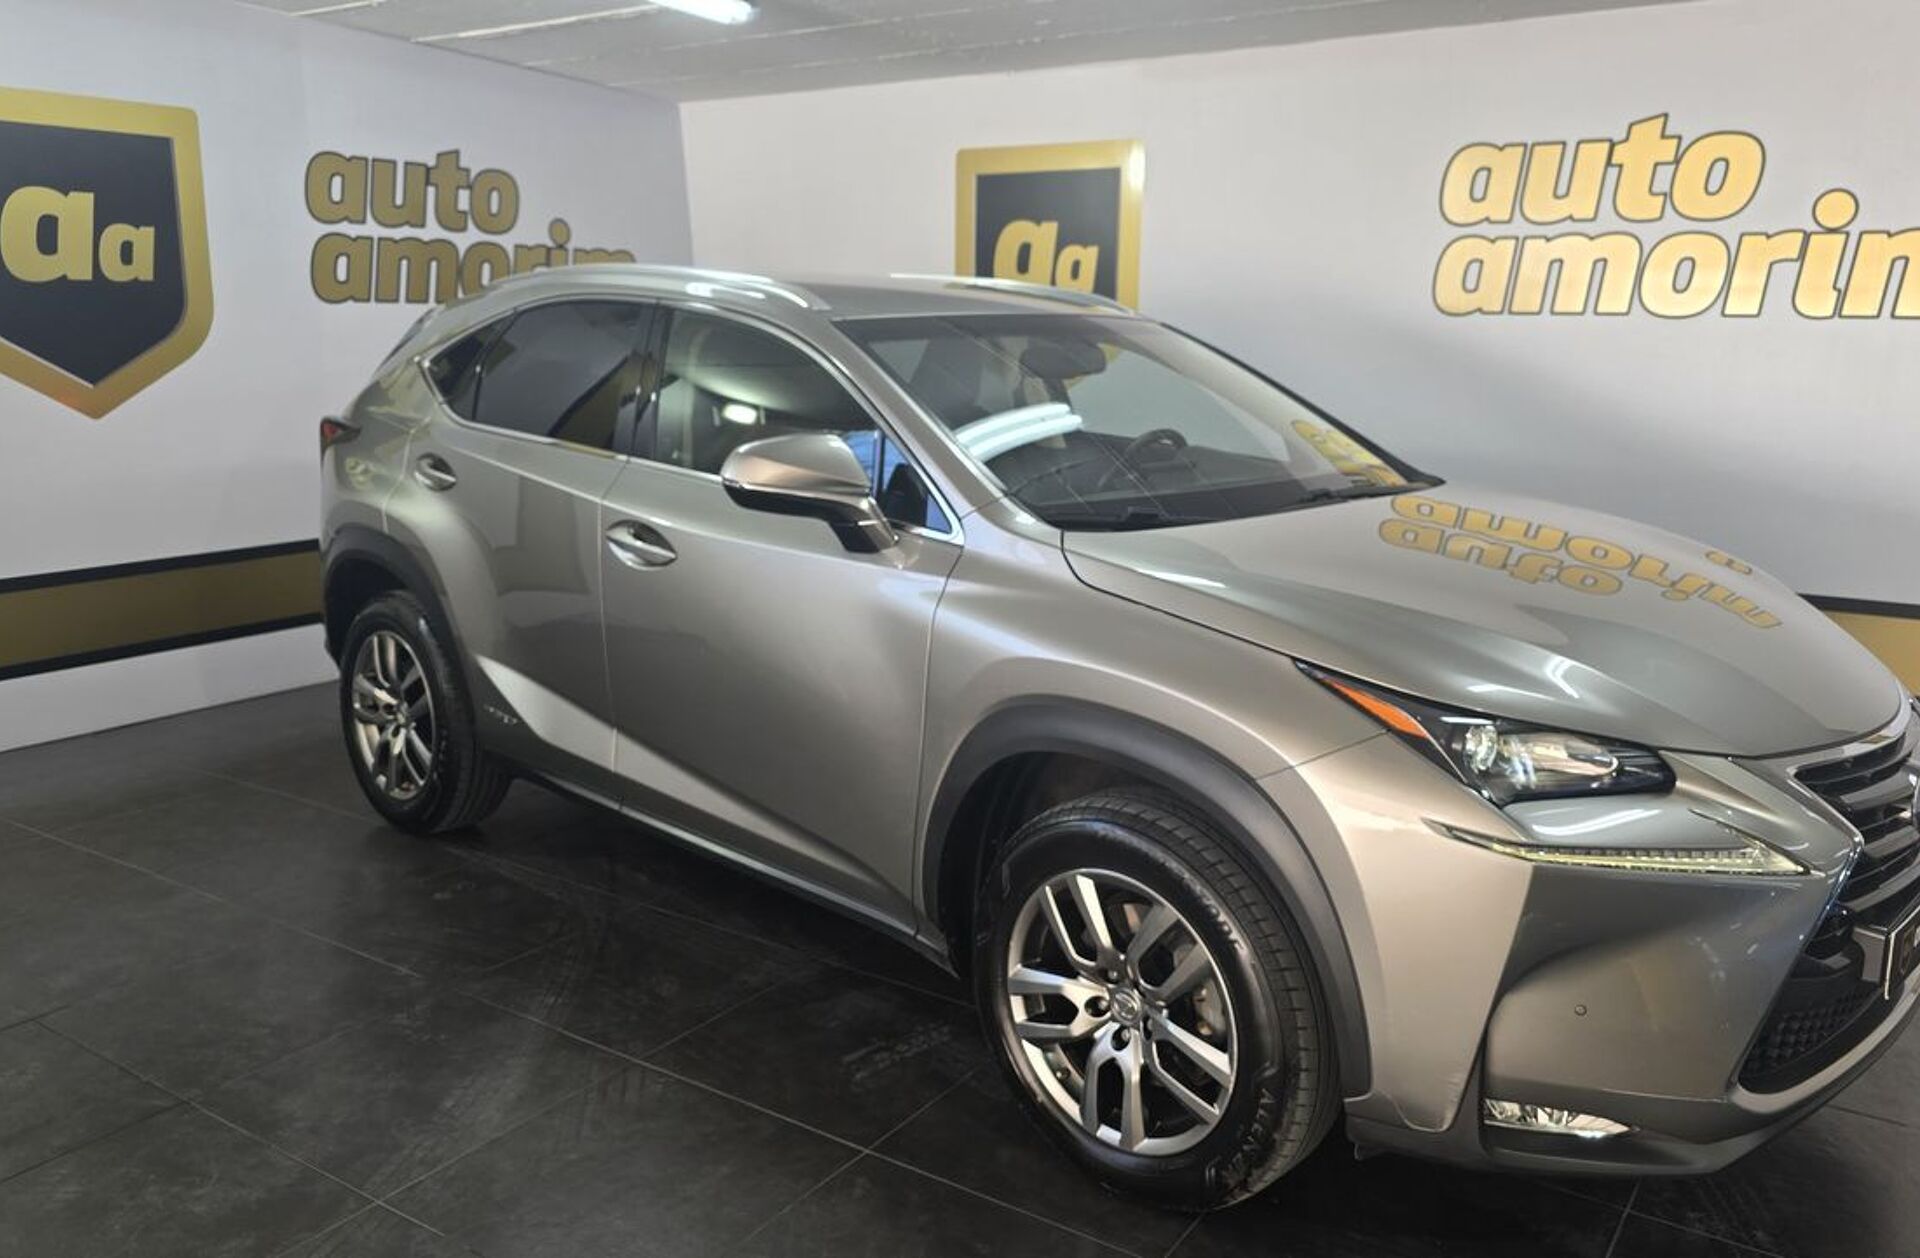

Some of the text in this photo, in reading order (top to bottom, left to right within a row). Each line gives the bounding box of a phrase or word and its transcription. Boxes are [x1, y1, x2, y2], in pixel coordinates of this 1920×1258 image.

[305, 150, 520, 234] auto
[1439, 113, 1766, 226] auto
[311, 217, 636, 304] amori
